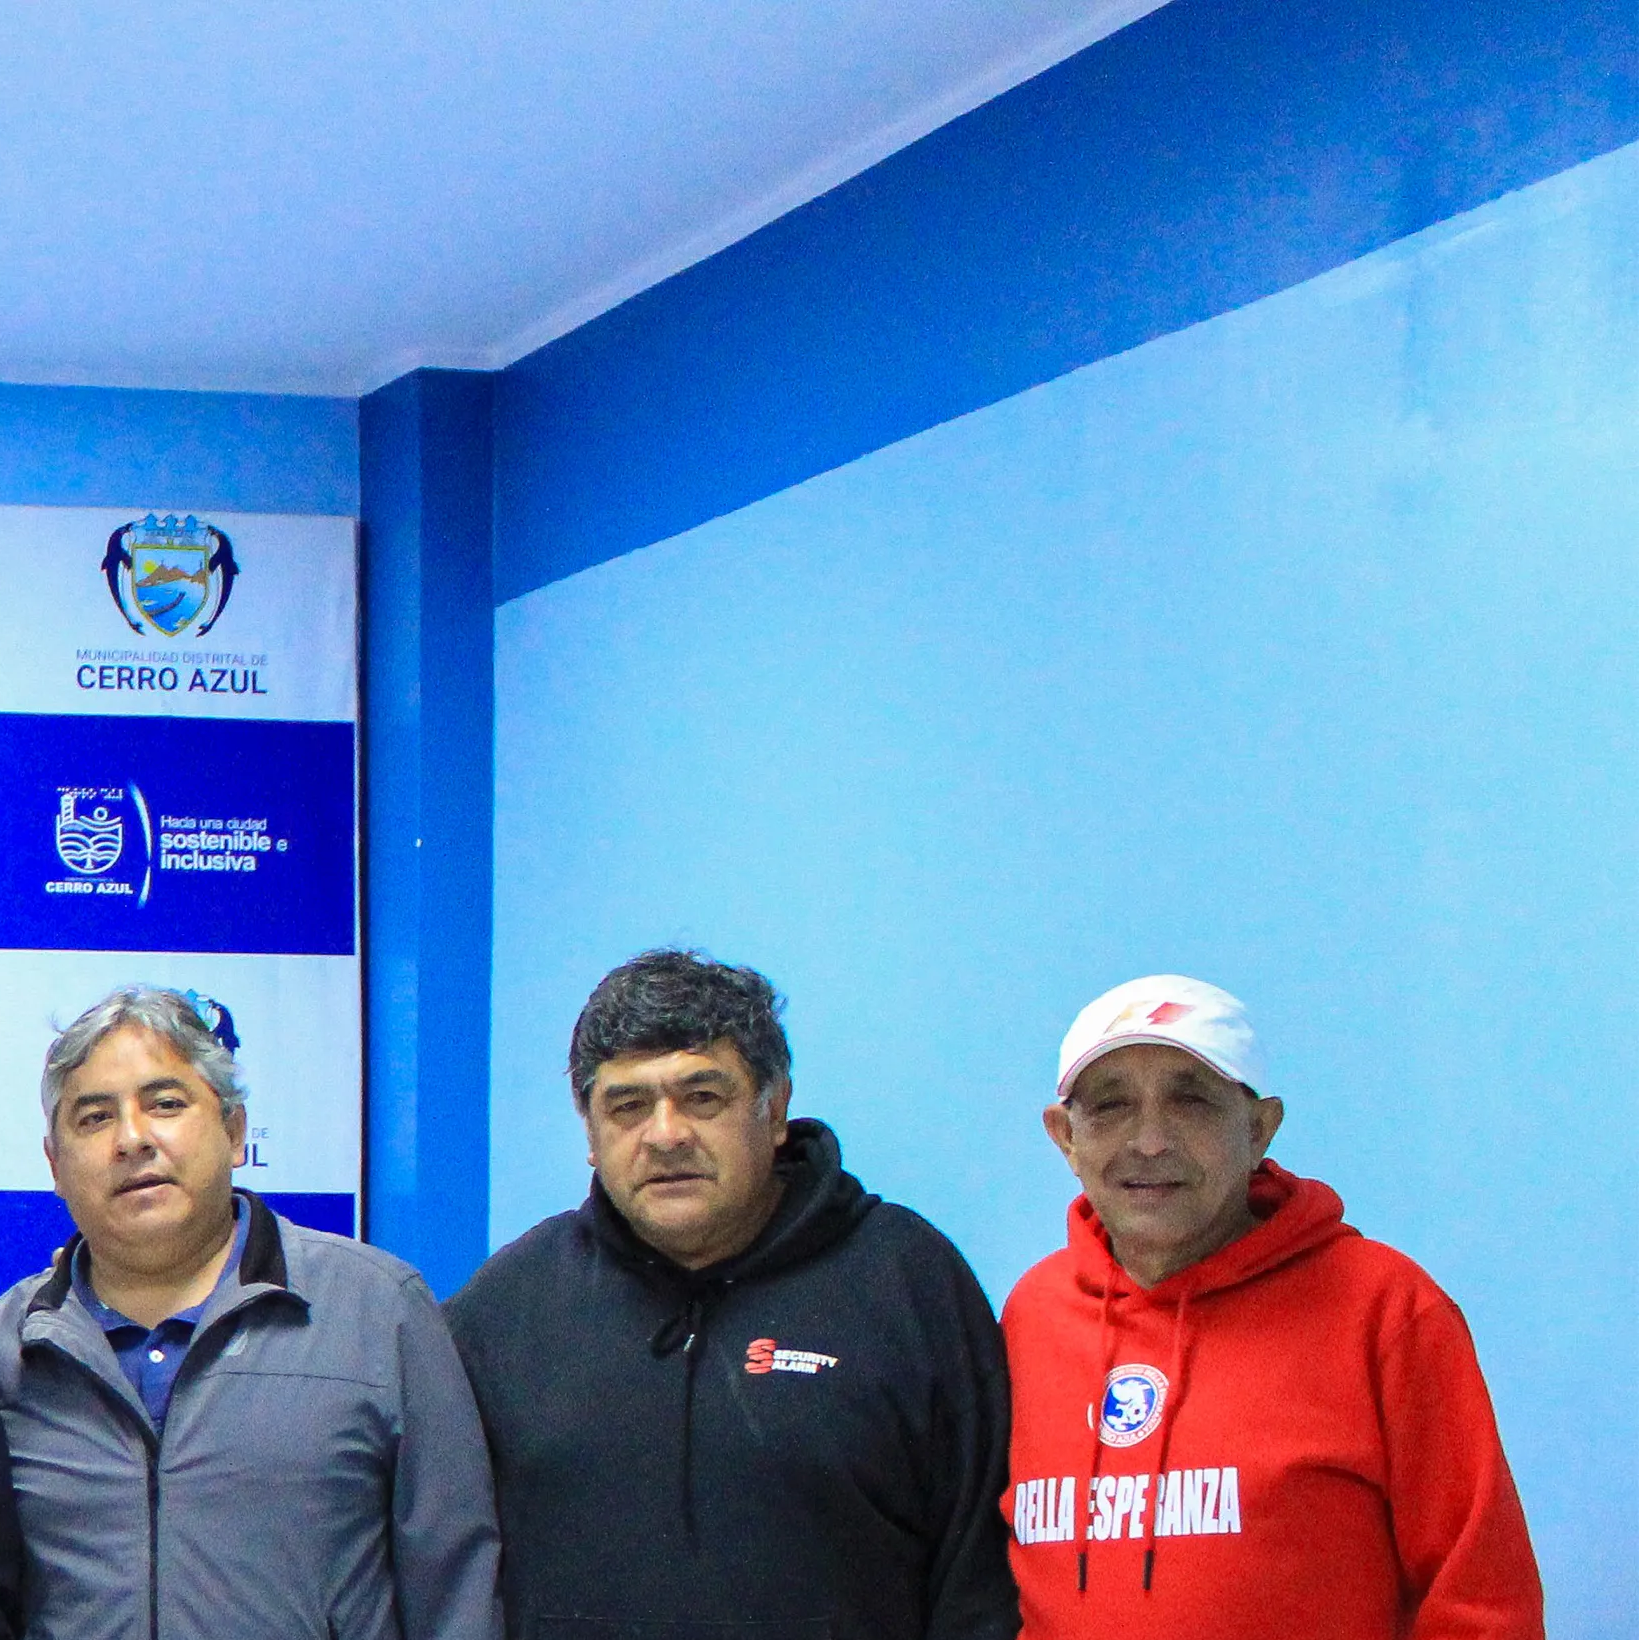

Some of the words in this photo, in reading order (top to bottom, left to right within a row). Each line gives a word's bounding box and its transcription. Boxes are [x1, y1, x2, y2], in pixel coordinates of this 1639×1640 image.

[77, 649, 180, 667] MUNICIPALIDAD
[183, 651, 245, 667] DISTRITAL
[251, 651, 268, 666] DE
[77, 664, 179, 692] CERRO
[189, 668, 267, 693] AZUL
[161, 829, 271, 853] sostenible
[277, 833, 287, 851] e
[161, 850, 256, 871] inclusiva
[46, 882, 93, 893] CERRO
[96, 880, 133, 894] AZUL
